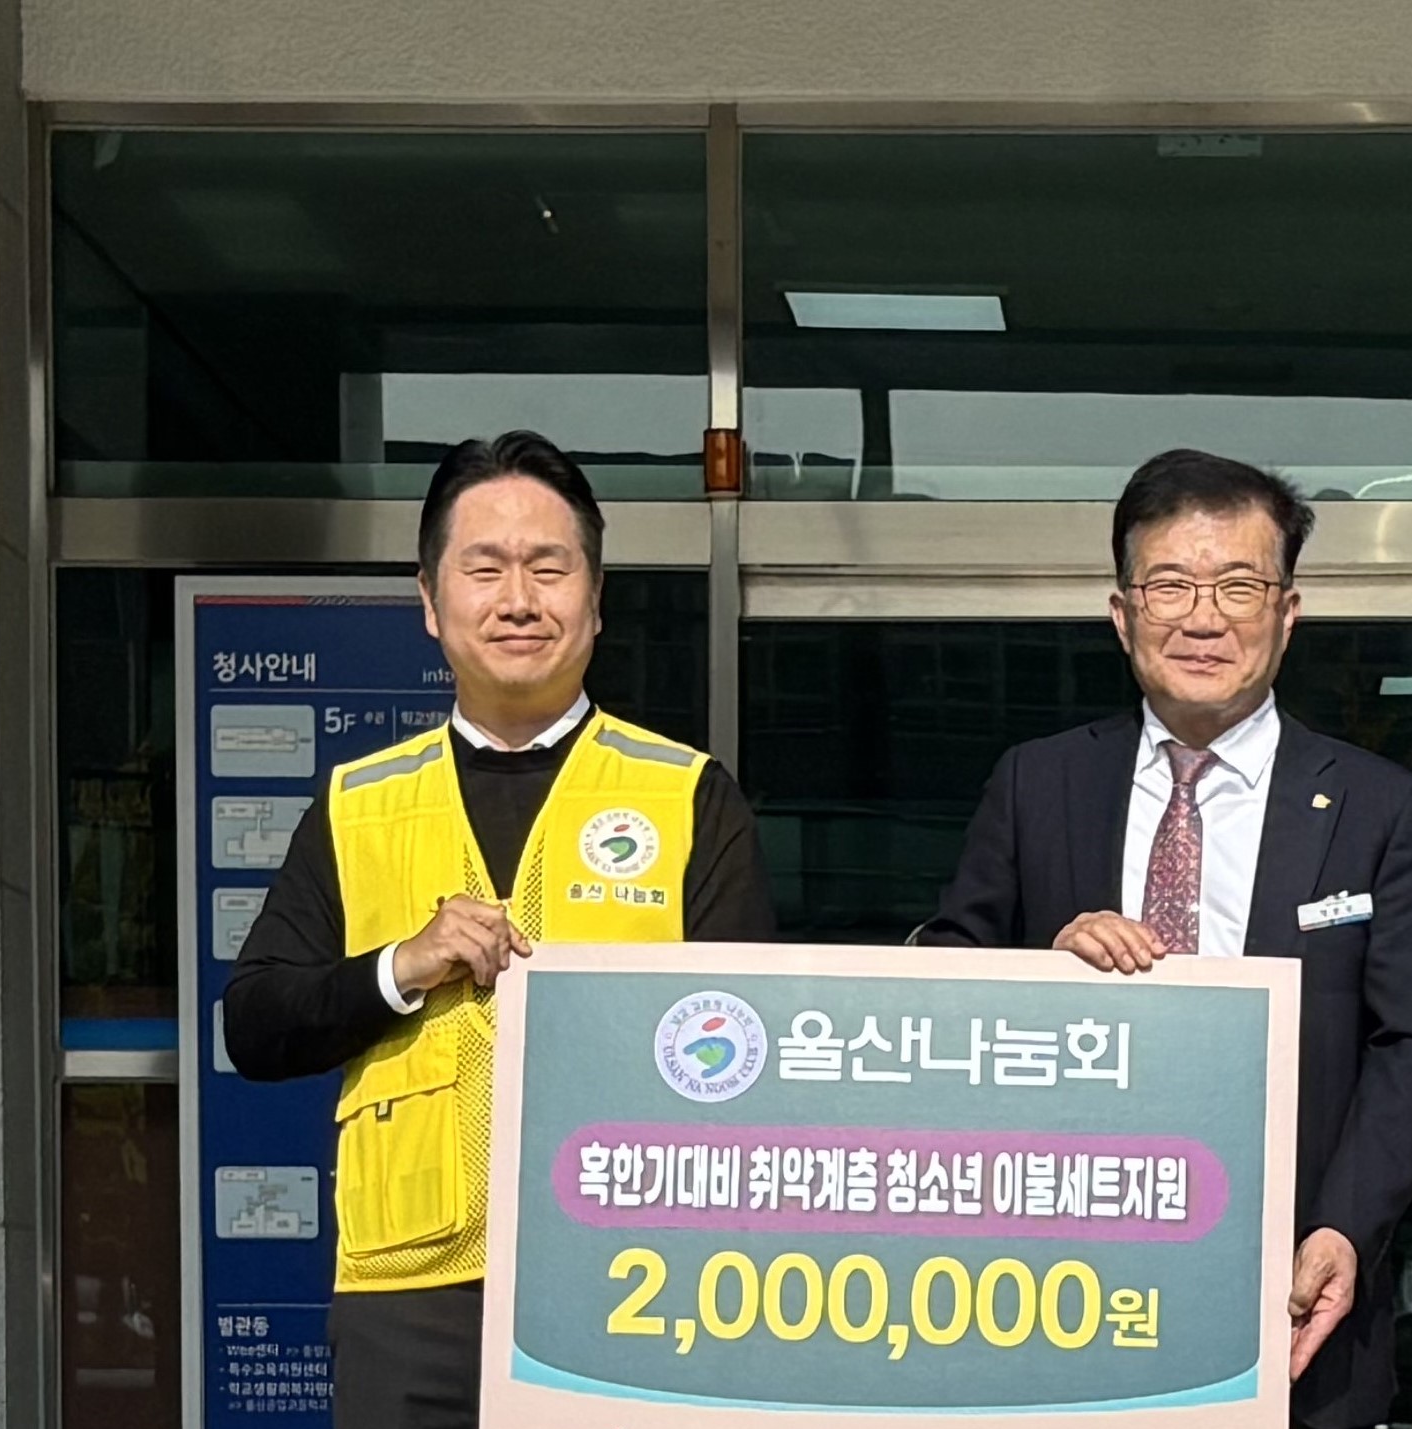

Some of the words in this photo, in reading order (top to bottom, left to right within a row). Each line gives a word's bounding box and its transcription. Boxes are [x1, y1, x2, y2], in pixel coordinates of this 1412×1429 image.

[213, 651, 316, 683] 청사안내
[324, 706, 357, 733] 5F
[570, 884, 602, 899] 울산
[615, 885, 665, 905] 나눔회
[777, 1010, 1131, 1090] 울산나눔회
[579, 1141, 741, 1210] 혹한기대비
[749, 1145, 879, 1214] 취약계층
[887, 1148, 984, 1216] 청소년
[992, 1151, 1188, 1221] 이불세트지원
[606, 1246, 1160, 1361] 2,000,000원
